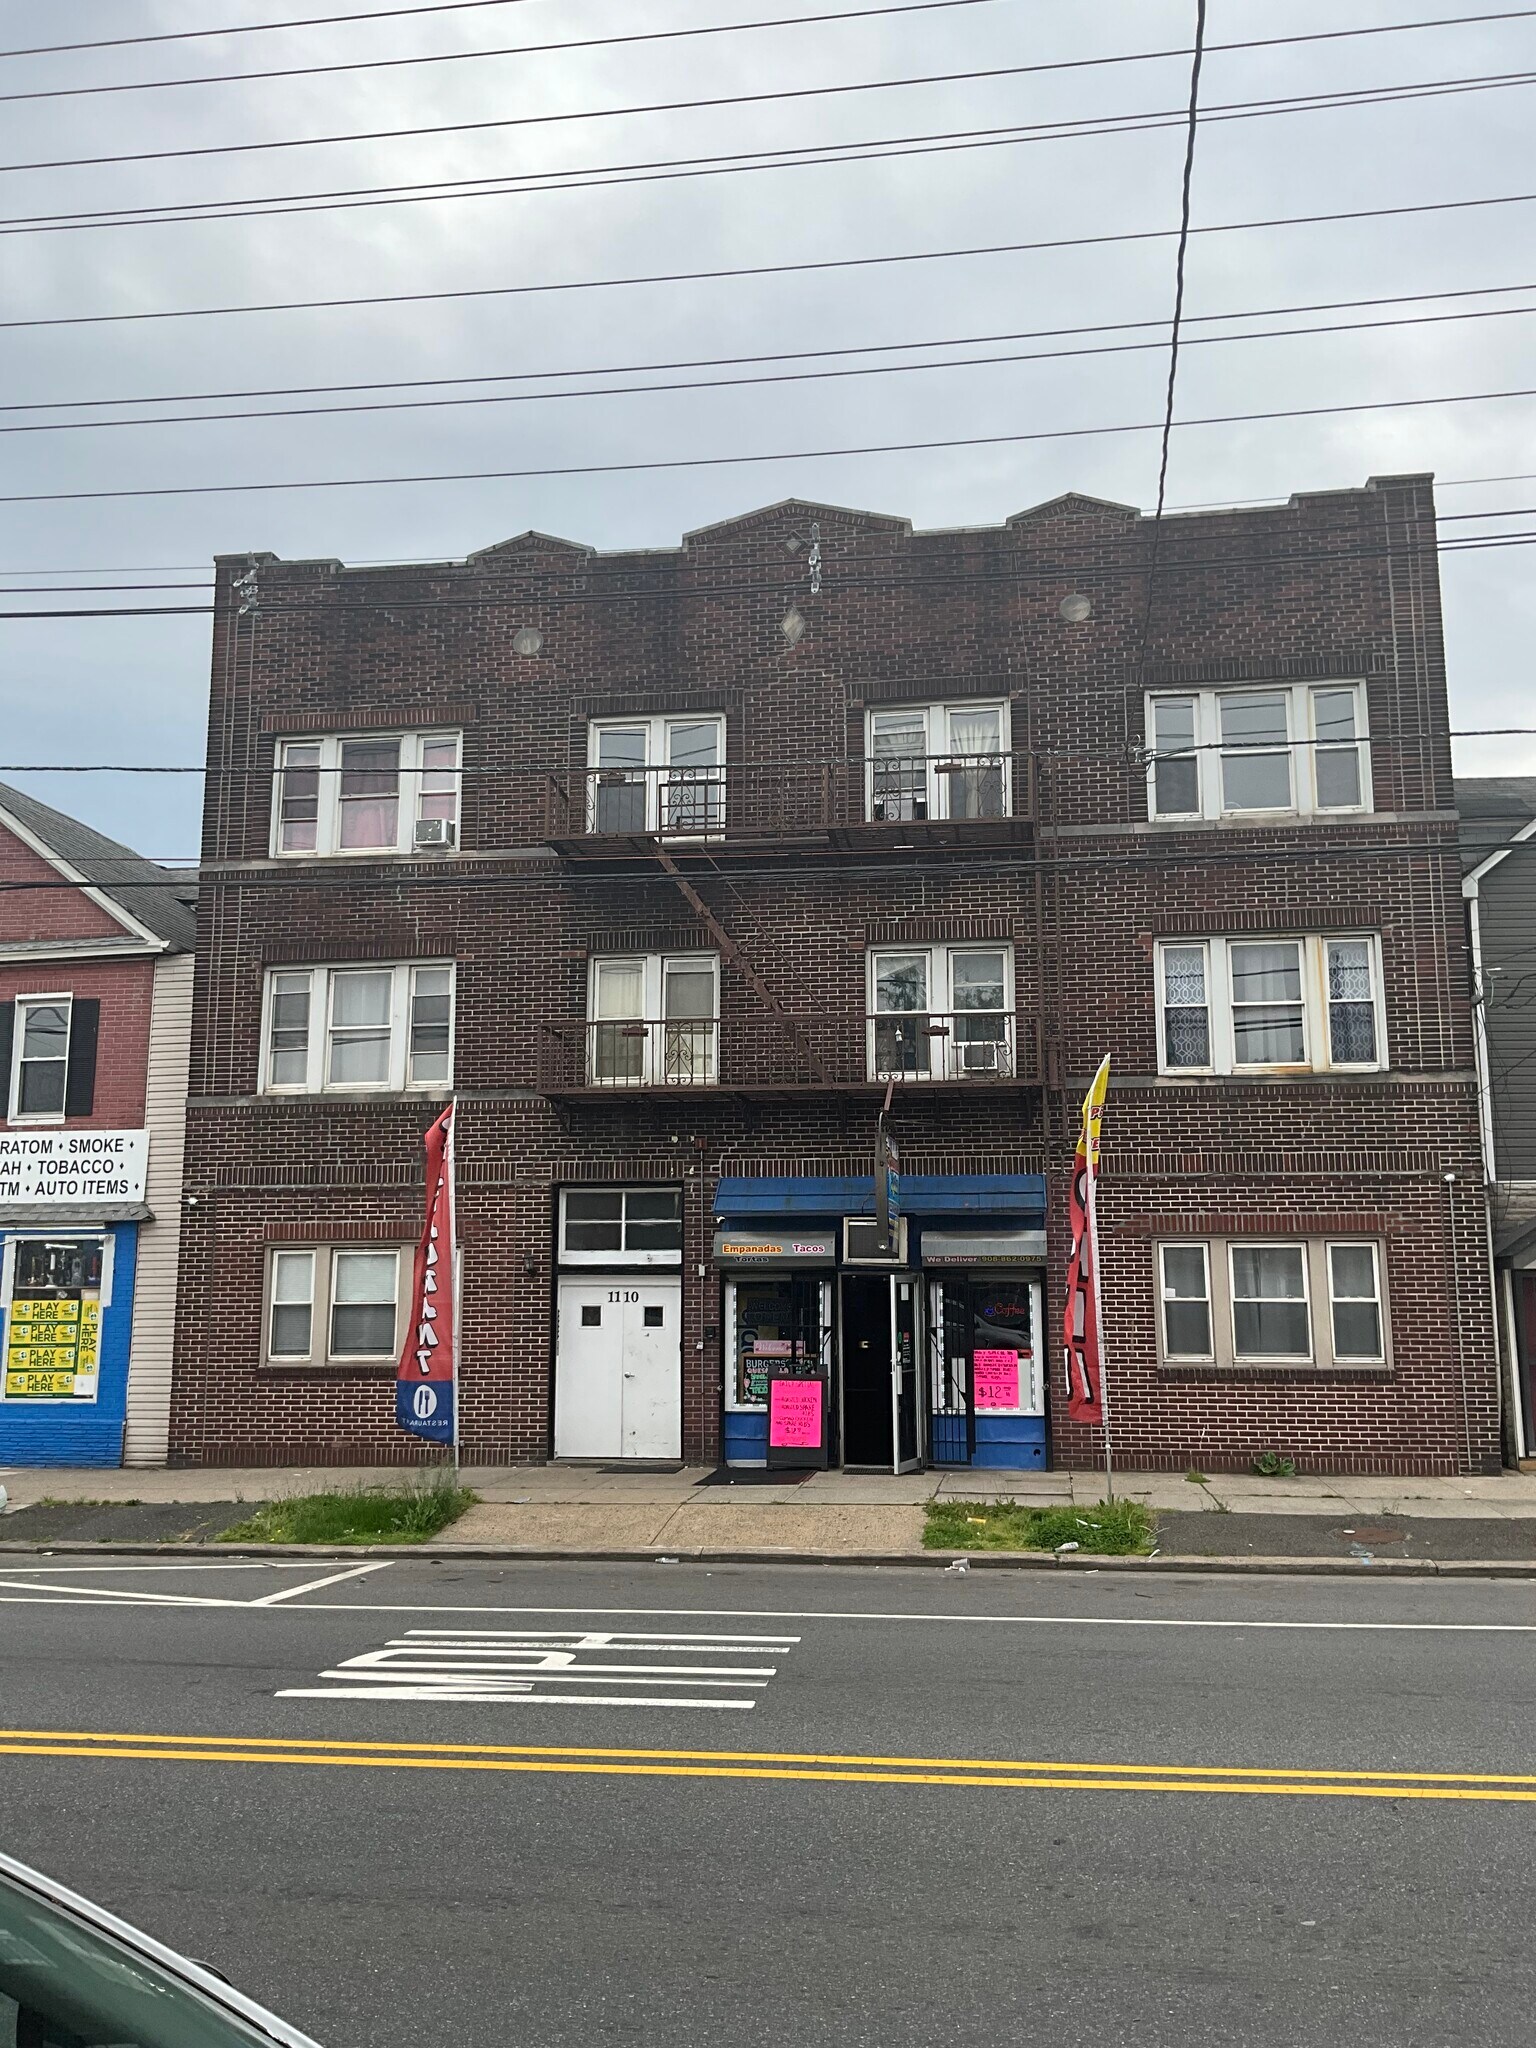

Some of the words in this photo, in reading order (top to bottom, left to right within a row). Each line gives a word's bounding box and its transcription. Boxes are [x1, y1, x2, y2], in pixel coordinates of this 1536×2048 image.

[69, 1138, 124, 1153] SMOKE
[38, 1159, 114, 1175] TOBACCO
[35, 1180, 78, 1195] AUTO
[82, 1180, 129, 1194] ITEMS
[723, 1244, 782, 1255] Empanadas
[792, 1244, 825, 1253] Tacos
[33, 1302, 59, 1310] PLAY
[994, 1303, 1025, 1317] Coffee
[32, 1311, 58, 1319] HERE
[31, 1325, 58, 1333] PLAY
[30, 1334, 57, 1342] HERE
[81, 1324, 89, 1352] HERE
[88, 1324, 98, 1353] PLAY
[29, 1350, 56, 1358] PLAY
[29, 1358, 55, 1366] HERE
[27, 1375, 54, 1383] PLAY
[27, 1383, 53, 1391] HERE
